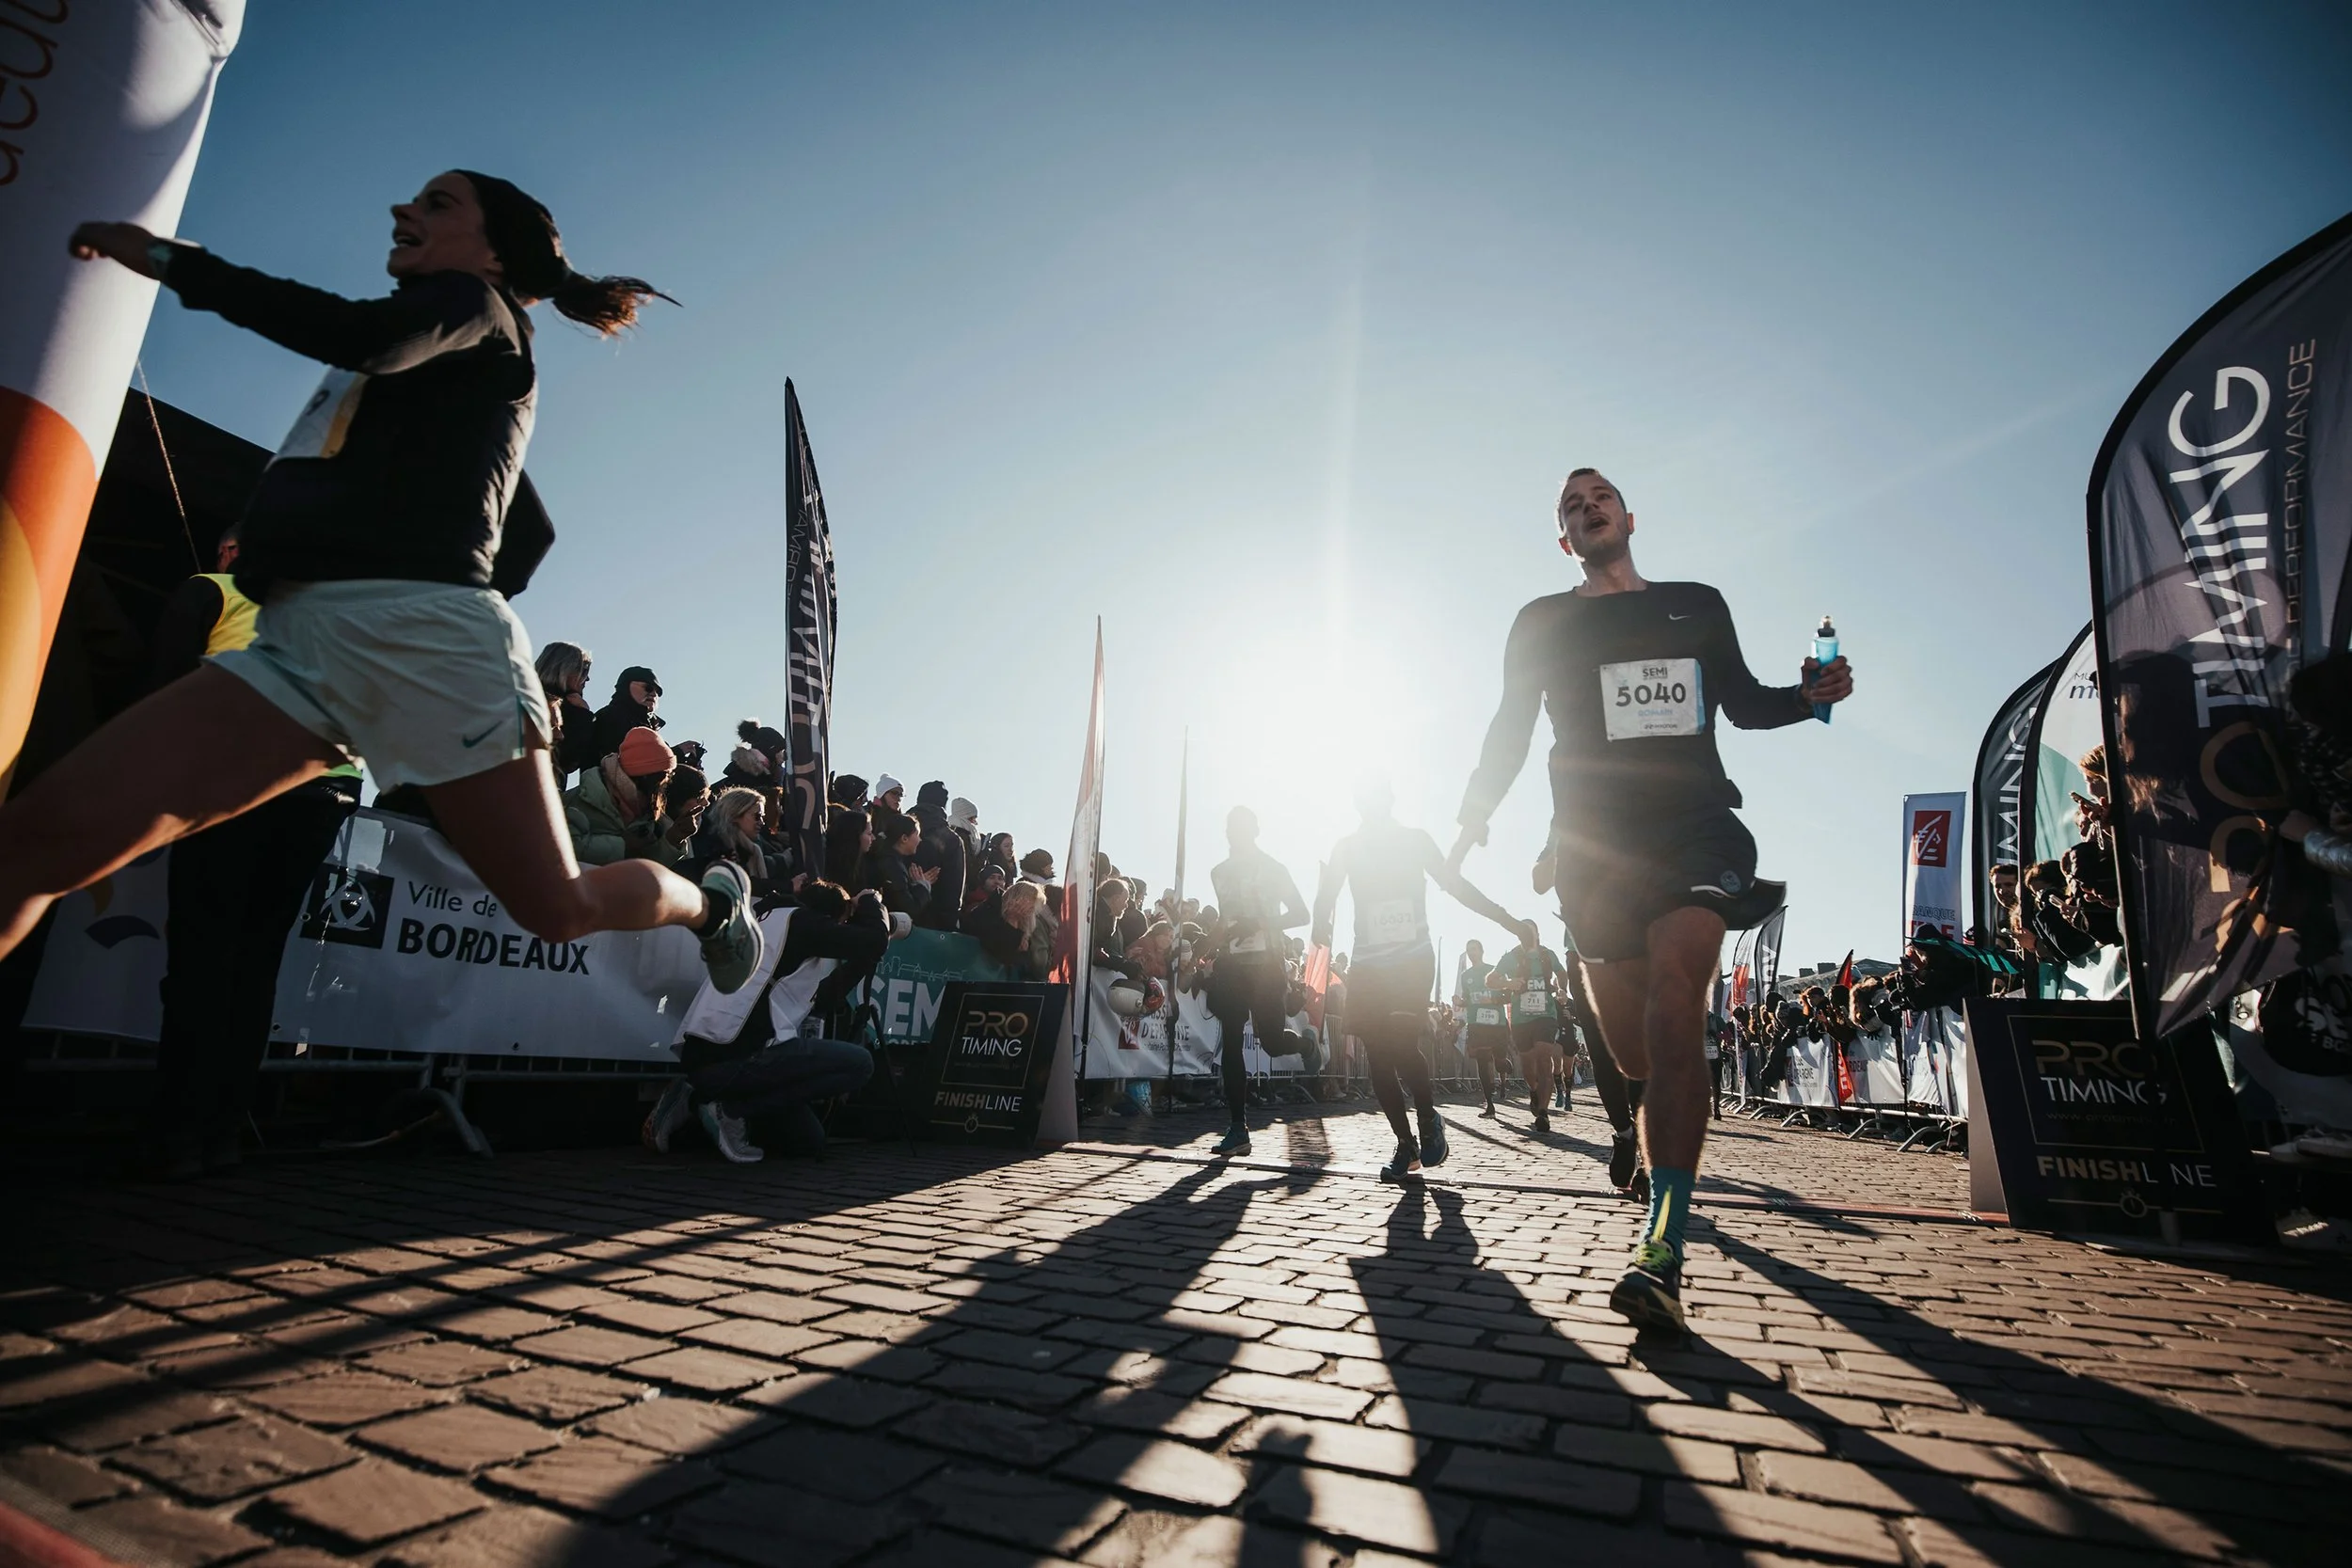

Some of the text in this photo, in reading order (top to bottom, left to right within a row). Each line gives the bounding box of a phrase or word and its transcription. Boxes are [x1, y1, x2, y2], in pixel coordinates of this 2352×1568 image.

[2169, 367, 2271, 729] TIMING
[1643, 667, 1668, 677] SEMI
[1615, 682, 1687, 707] 5040
[408, 880, 497, 918] Ville de
[397, 917, 590, 975] BORDEAUX
[963, 1010, 1029, 1037] PRO
[961, 1037, 1023, 1057] TIMING
[933, 1091, 1023, 1112] FINISHLINE
[2036, 1155, 2217, 1187] FINISHLNE
